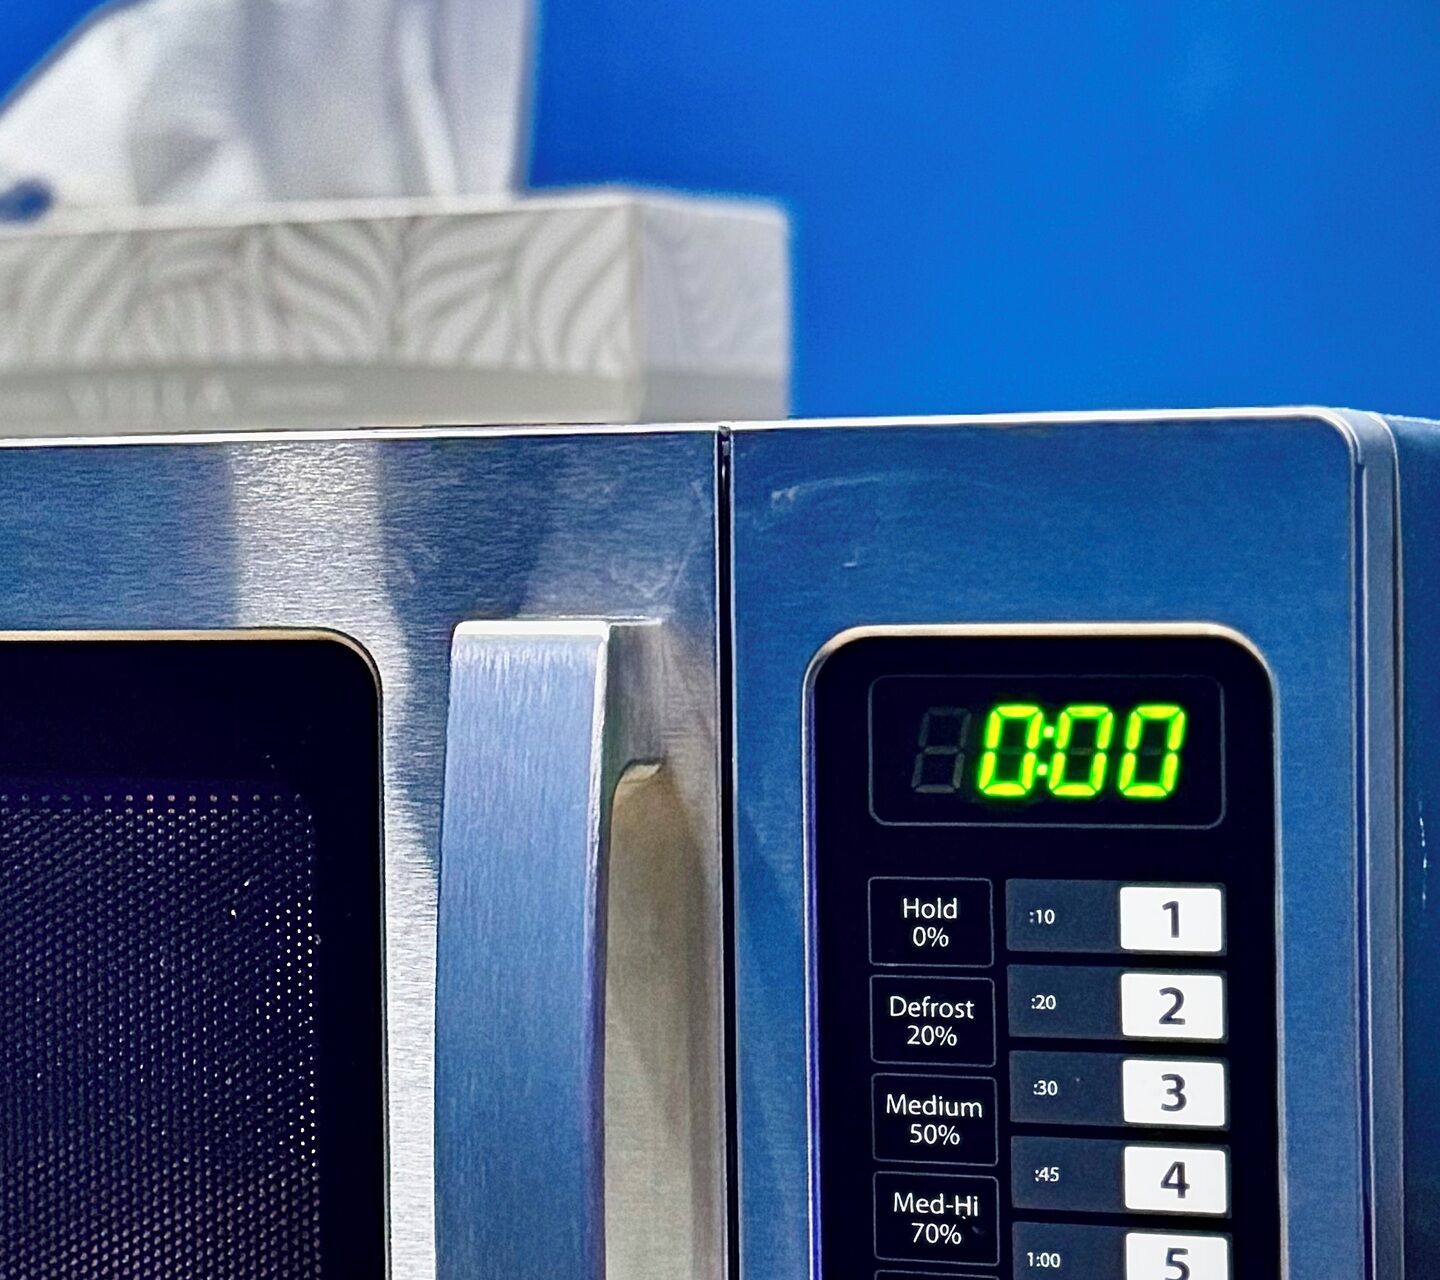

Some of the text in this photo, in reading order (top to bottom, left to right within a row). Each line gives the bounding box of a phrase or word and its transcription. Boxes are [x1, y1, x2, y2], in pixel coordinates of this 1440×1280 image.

[976, 703, 1187, 800] 0:00
[902, 898, 958, 920] Hold
[1029, 909, 1056, 925] :10
[1162, 901, 1180, 938] 1
[912, 926, 949, 948] 0%
[889, 995, 975, 1020] Defrost
[1031, 994, 1057, 1010] :20
[1158, 987, 1186, 1025] 2
[906, 1024, 958, 1047] 20%
[1033, 1080, 1058, 1097] :30
[1161, 1073, 1187, 1112] 3
[885, 1094, 983, 1119] Medium
[909, 1123, 961, 1146] 50%
[1034, 1166, 1060, 1182] :45
[1160, 1161, 1190, 1199] 4
[893, 1192, 979, 1218] Med-Hi
[911, 1222, 962, 1245] 70%
[1026, 1251, 1061, 1269] 1:00
